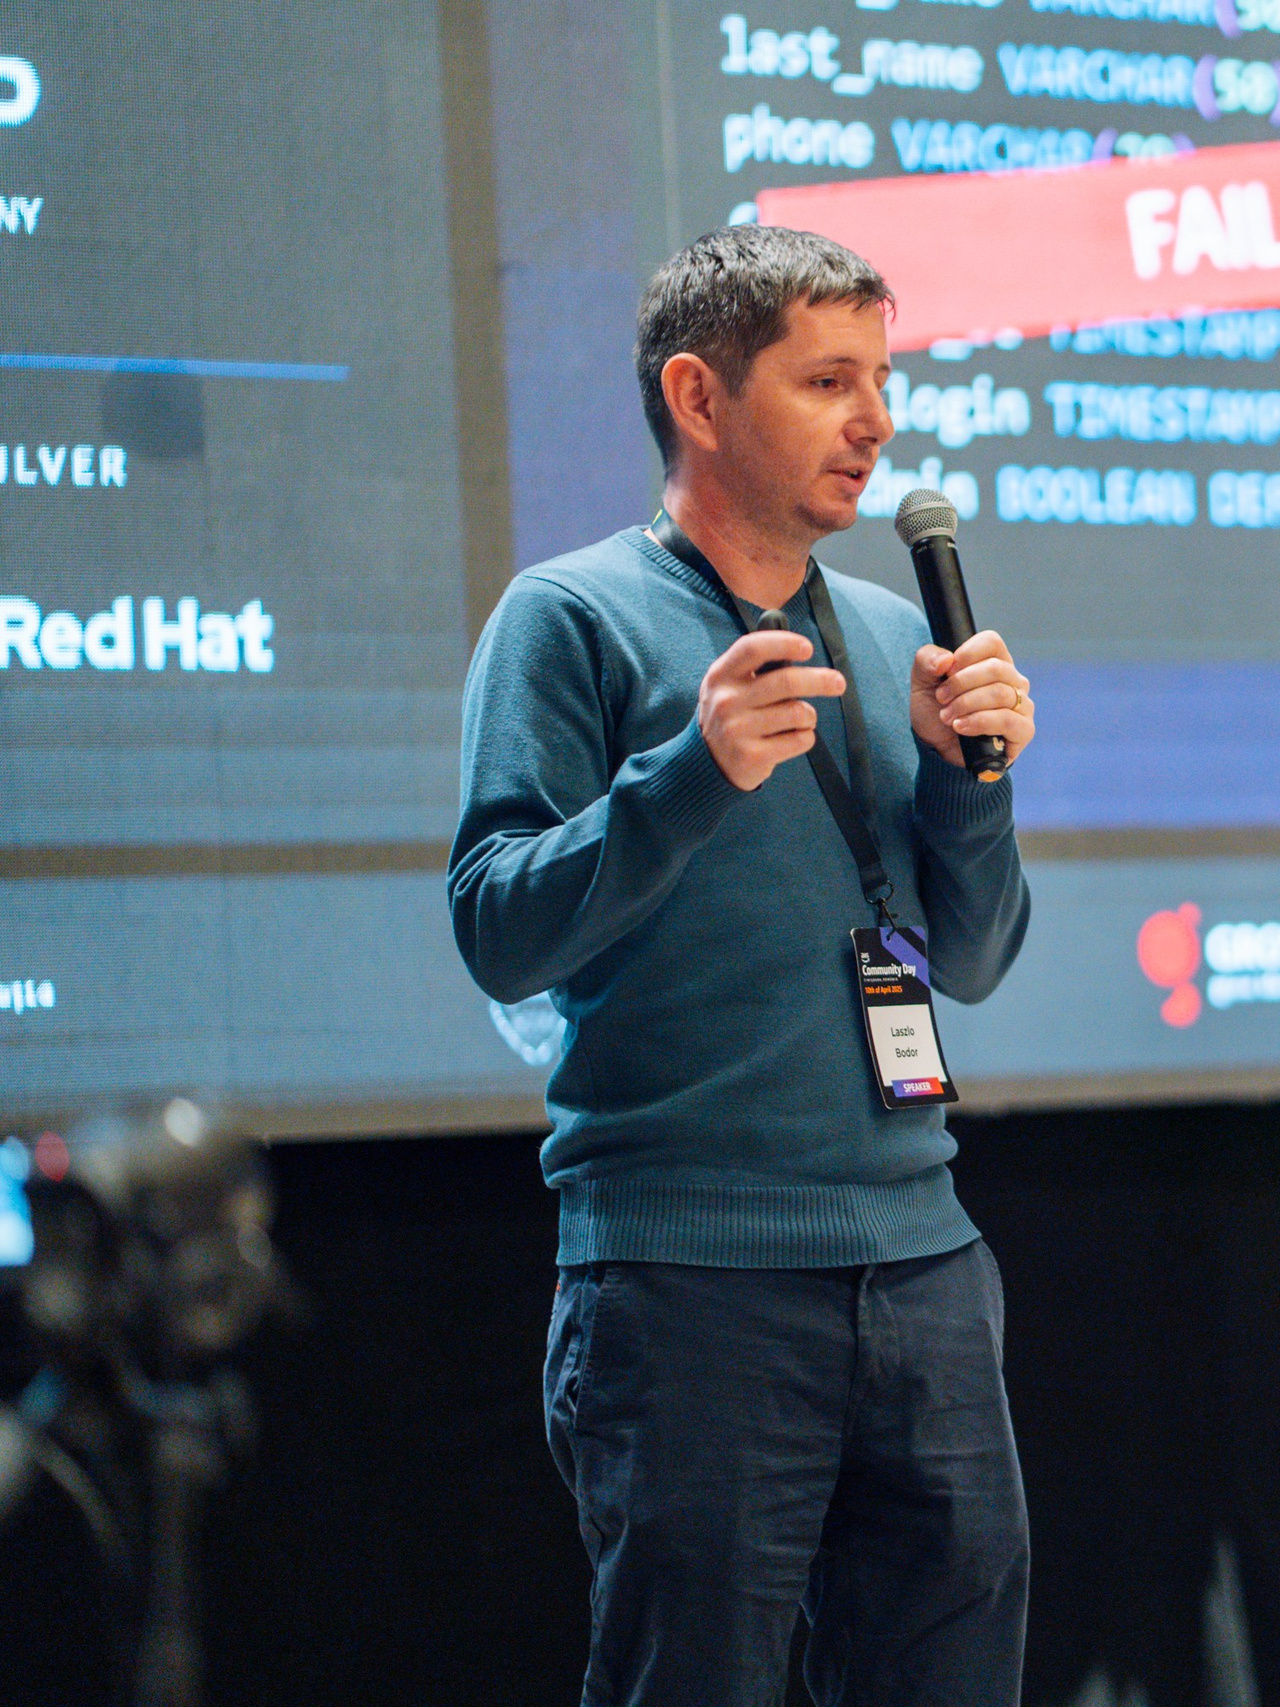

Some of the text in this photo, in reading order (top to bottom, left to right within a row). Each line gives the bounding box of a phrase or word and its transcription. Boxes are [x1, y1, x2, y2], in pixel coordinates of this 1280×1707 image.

[720, 14, 984, 96] last_name
[722, 103, 876, 173] phone
[0, 594, 275, 673] Red Hat
[861, 963, 917, 978] Community Day
[890, 1025, 915, 1037] Laszlo
[895, 1047, 919, 1058] Bodor
[903, 1082, 932, 1093] SPEAKER
